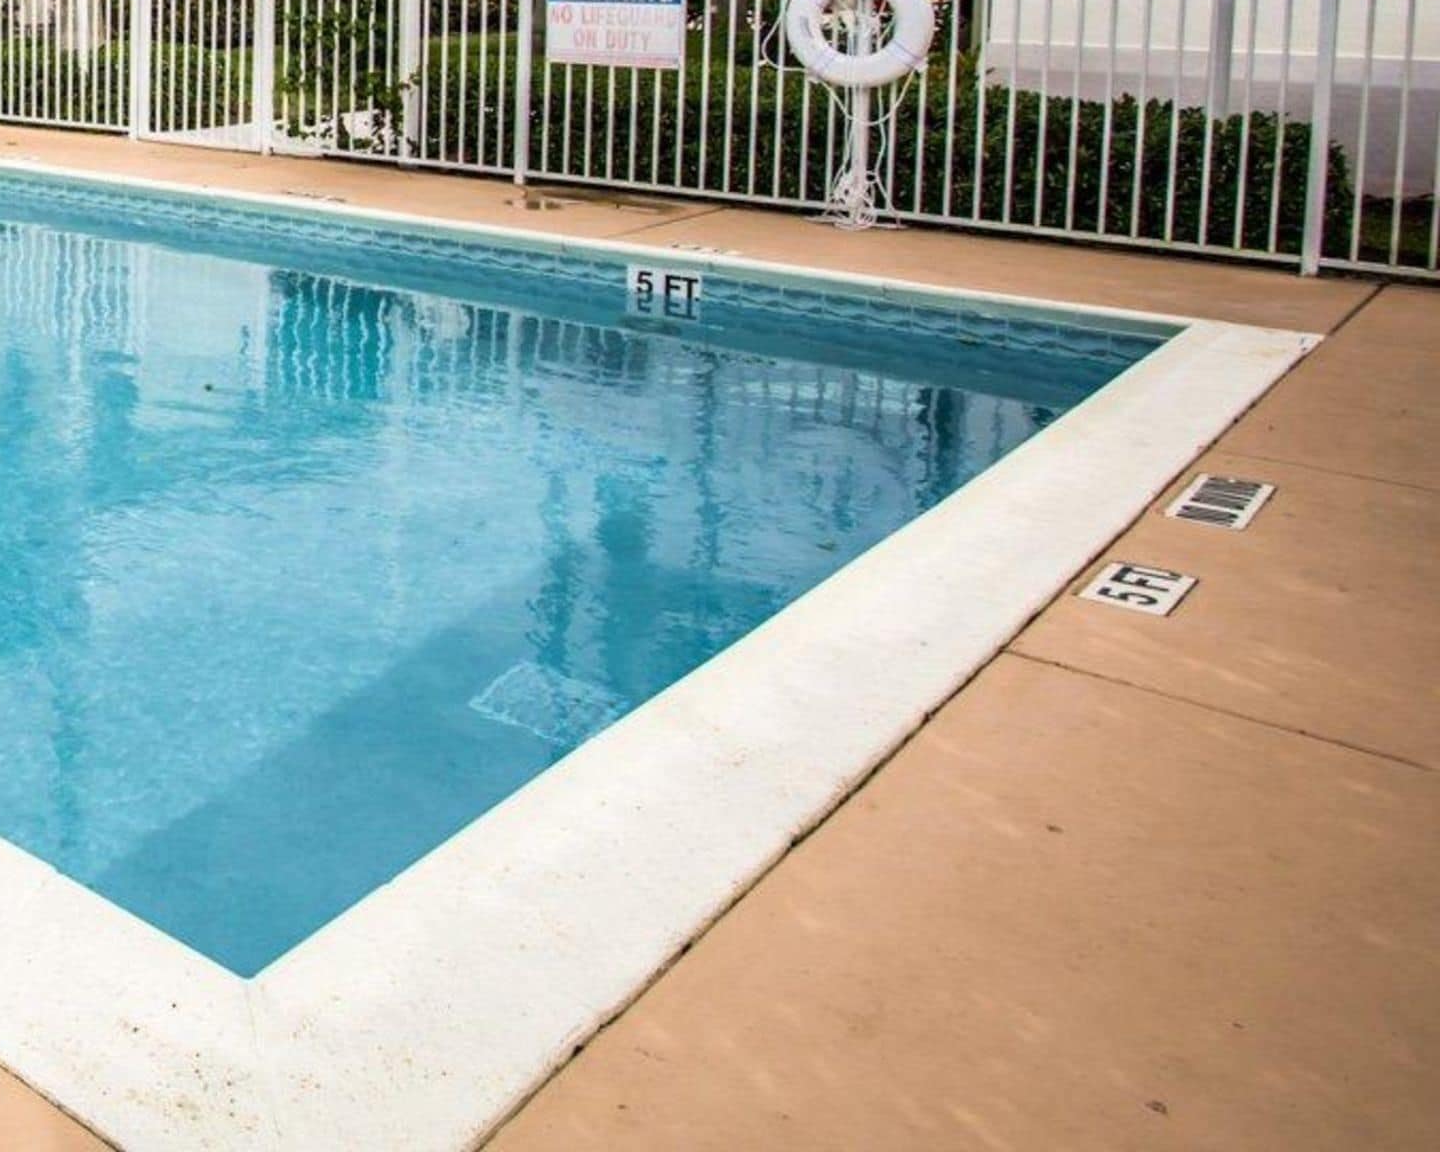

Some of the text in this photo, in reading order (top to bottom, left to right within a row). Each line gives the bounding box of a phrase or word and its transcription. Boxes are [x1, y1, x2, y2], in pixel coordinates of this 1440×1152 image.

[552, 4, 573, 24] NO
[606, 30, 651, 51] DUTY
[637, 271, 653, 294] 5
[1096, 586, 1159, 605] 5
